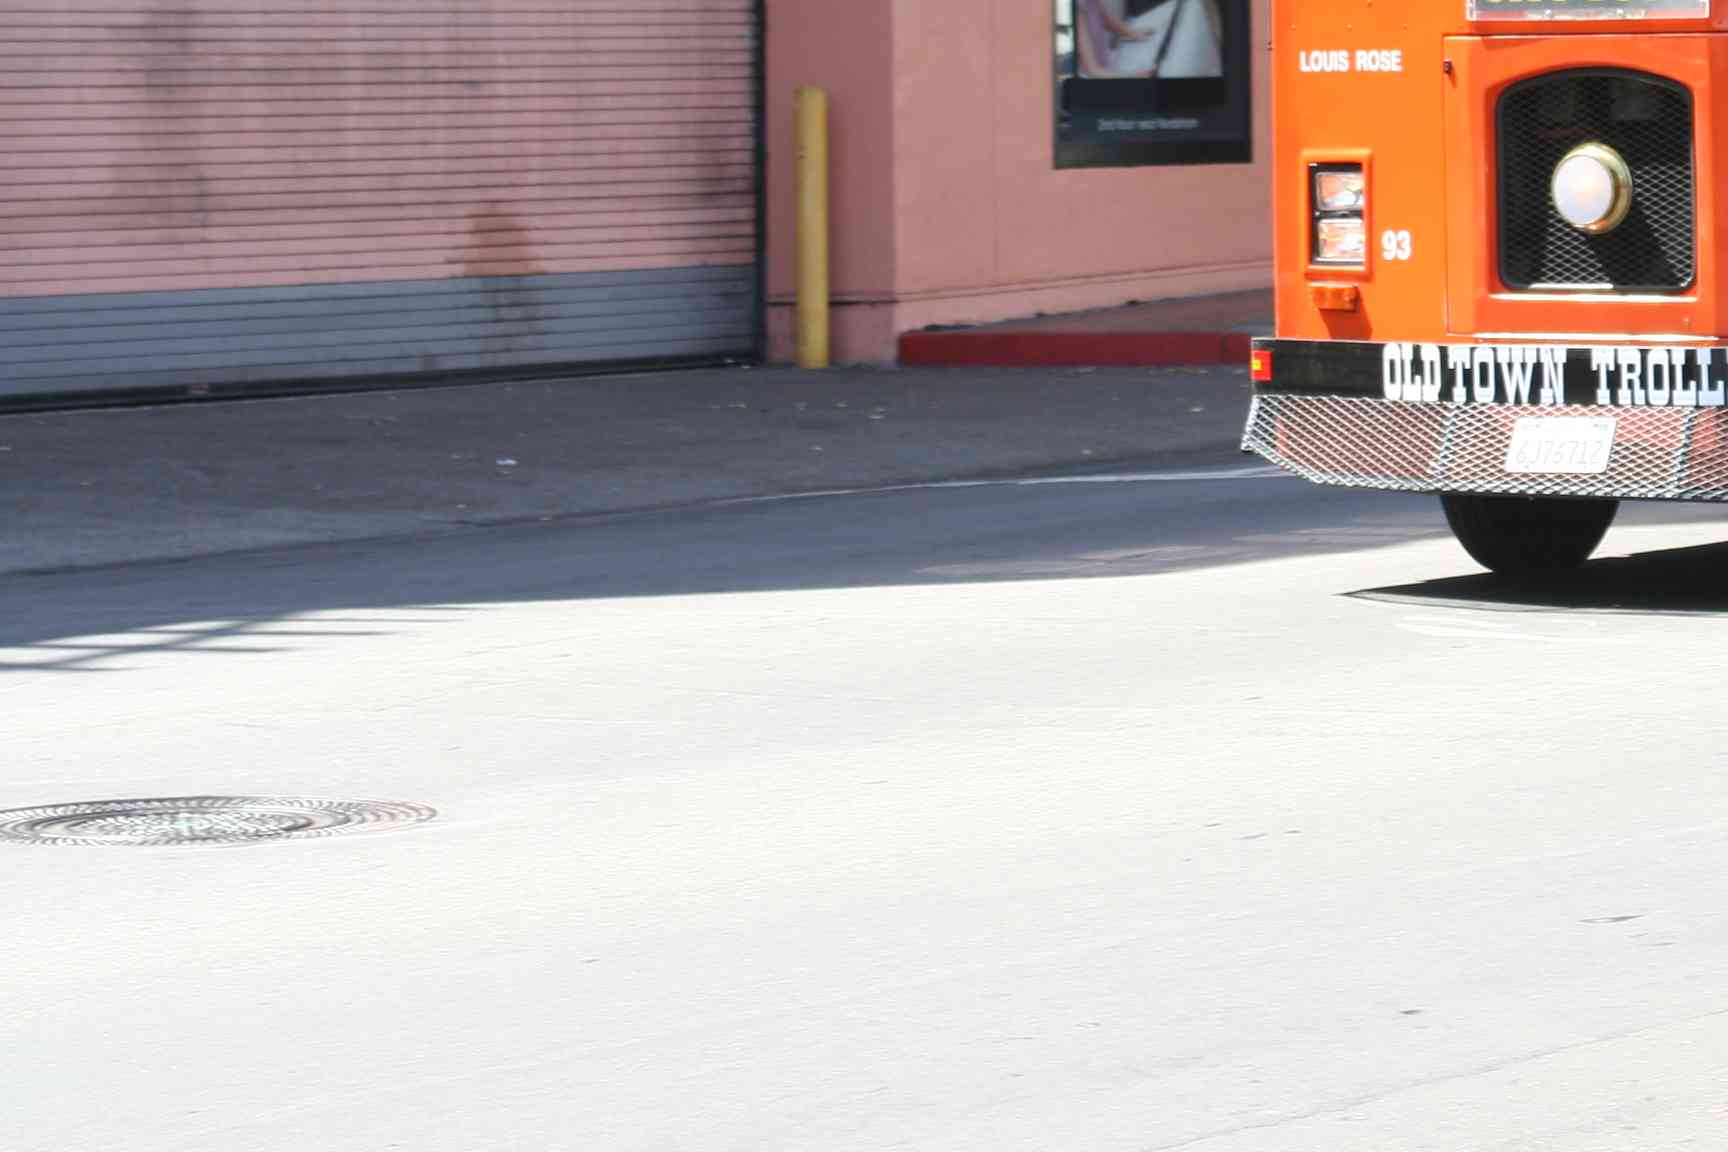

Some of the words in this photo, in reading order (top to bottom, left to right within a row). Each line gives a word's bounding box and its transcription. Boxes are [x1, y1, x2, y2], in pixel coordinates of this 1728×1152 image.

[1298, 49, 1349, 72] LOUIS
[1355, 49, 1403, 72] ROSE
[1381, 229, 1412, 261] 93
[1382, 342, 1441, 401] OLD
[1447, 347, 1566, 405] TOWN
